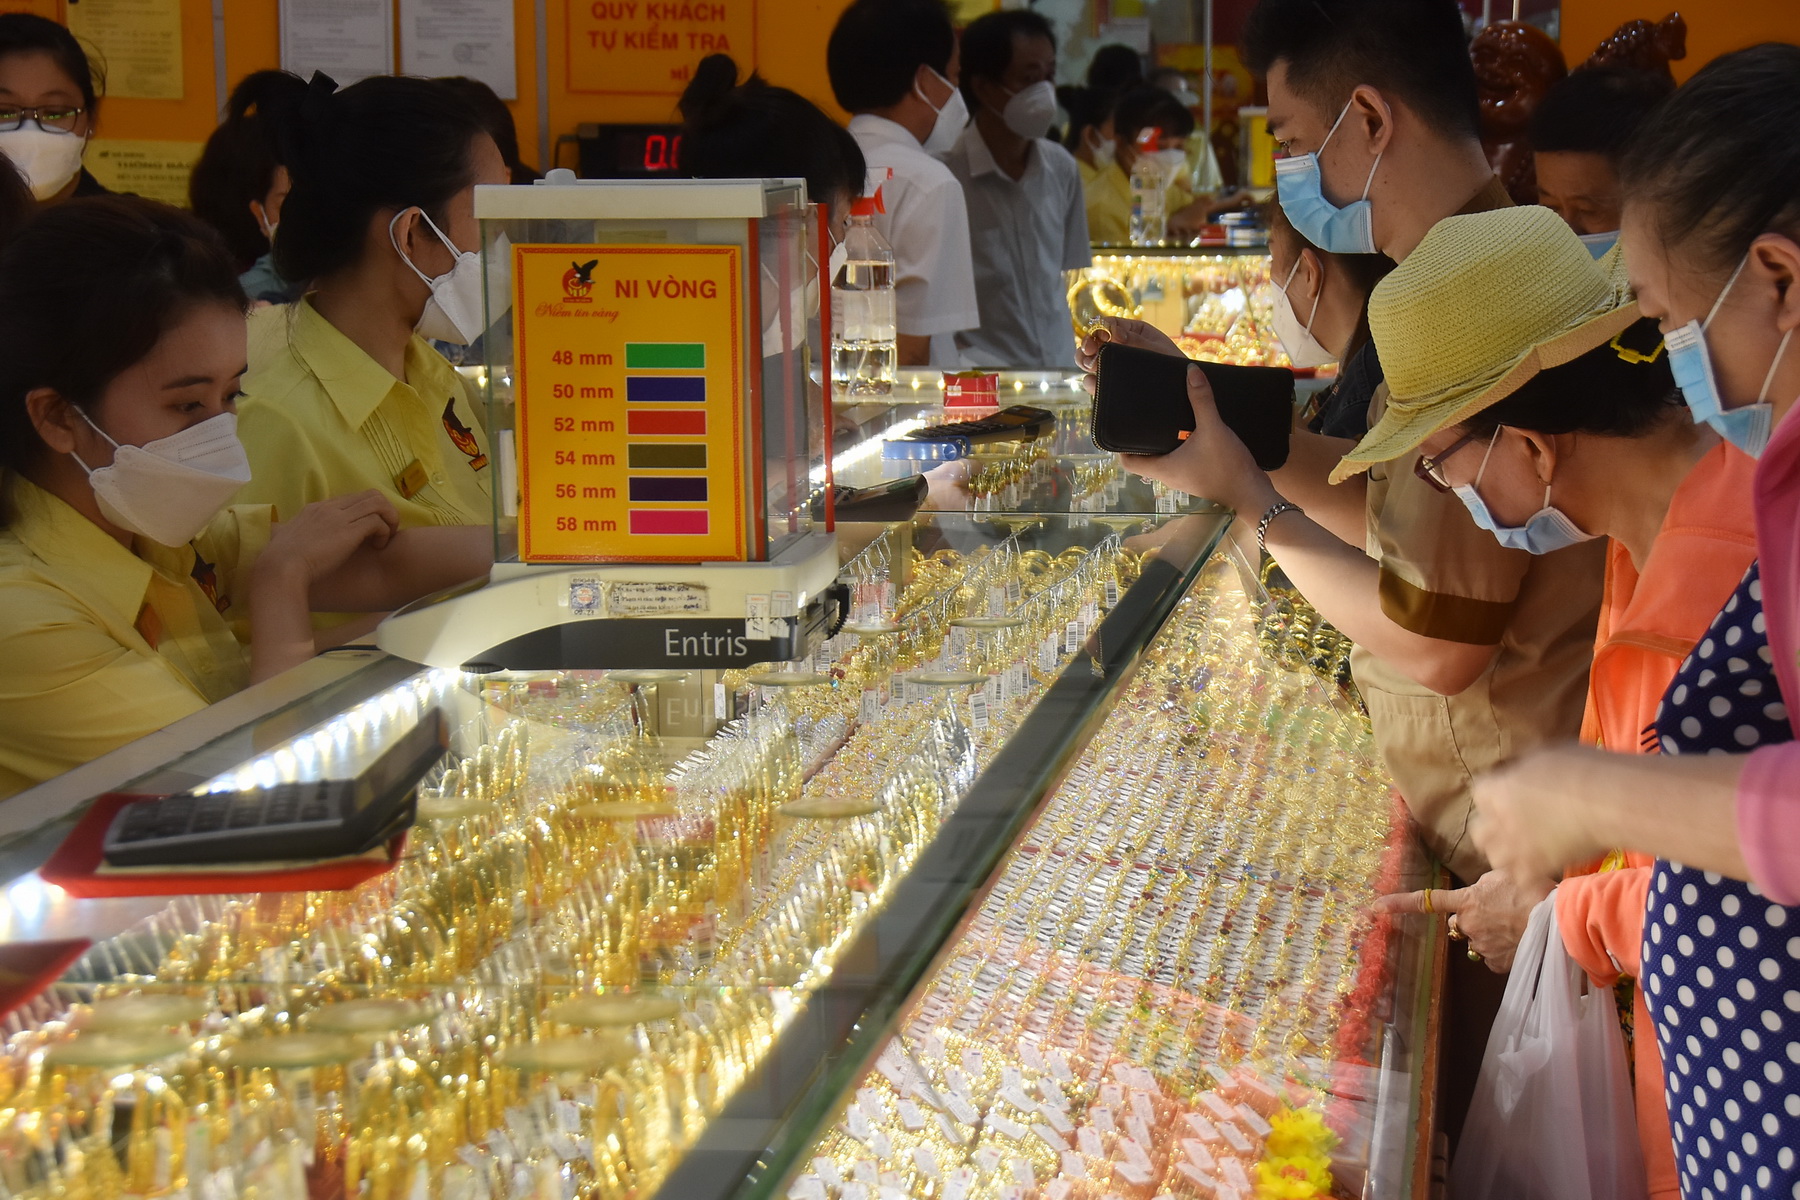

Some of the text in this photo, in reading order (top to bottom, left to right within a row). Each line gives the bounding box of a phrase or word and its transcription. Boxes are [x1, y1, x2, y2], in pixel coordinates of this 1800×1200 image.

[686, 33, 730, 50] TRA
[614, 274, 718, 299] NI VÒNG
[574, 308, 590, 318] tin
[552, 351, 613, 365] 48 mm
[553, 384, 614, 398] 50 mm
[554, 417, 615, 432] 52 mm
[555, 451, 616, 465] 54 mm
[556, 484, 616, 499] 56 mm
[556, 517, 617, 532] 58 mm
[665, 629, 748, 657] Entris
